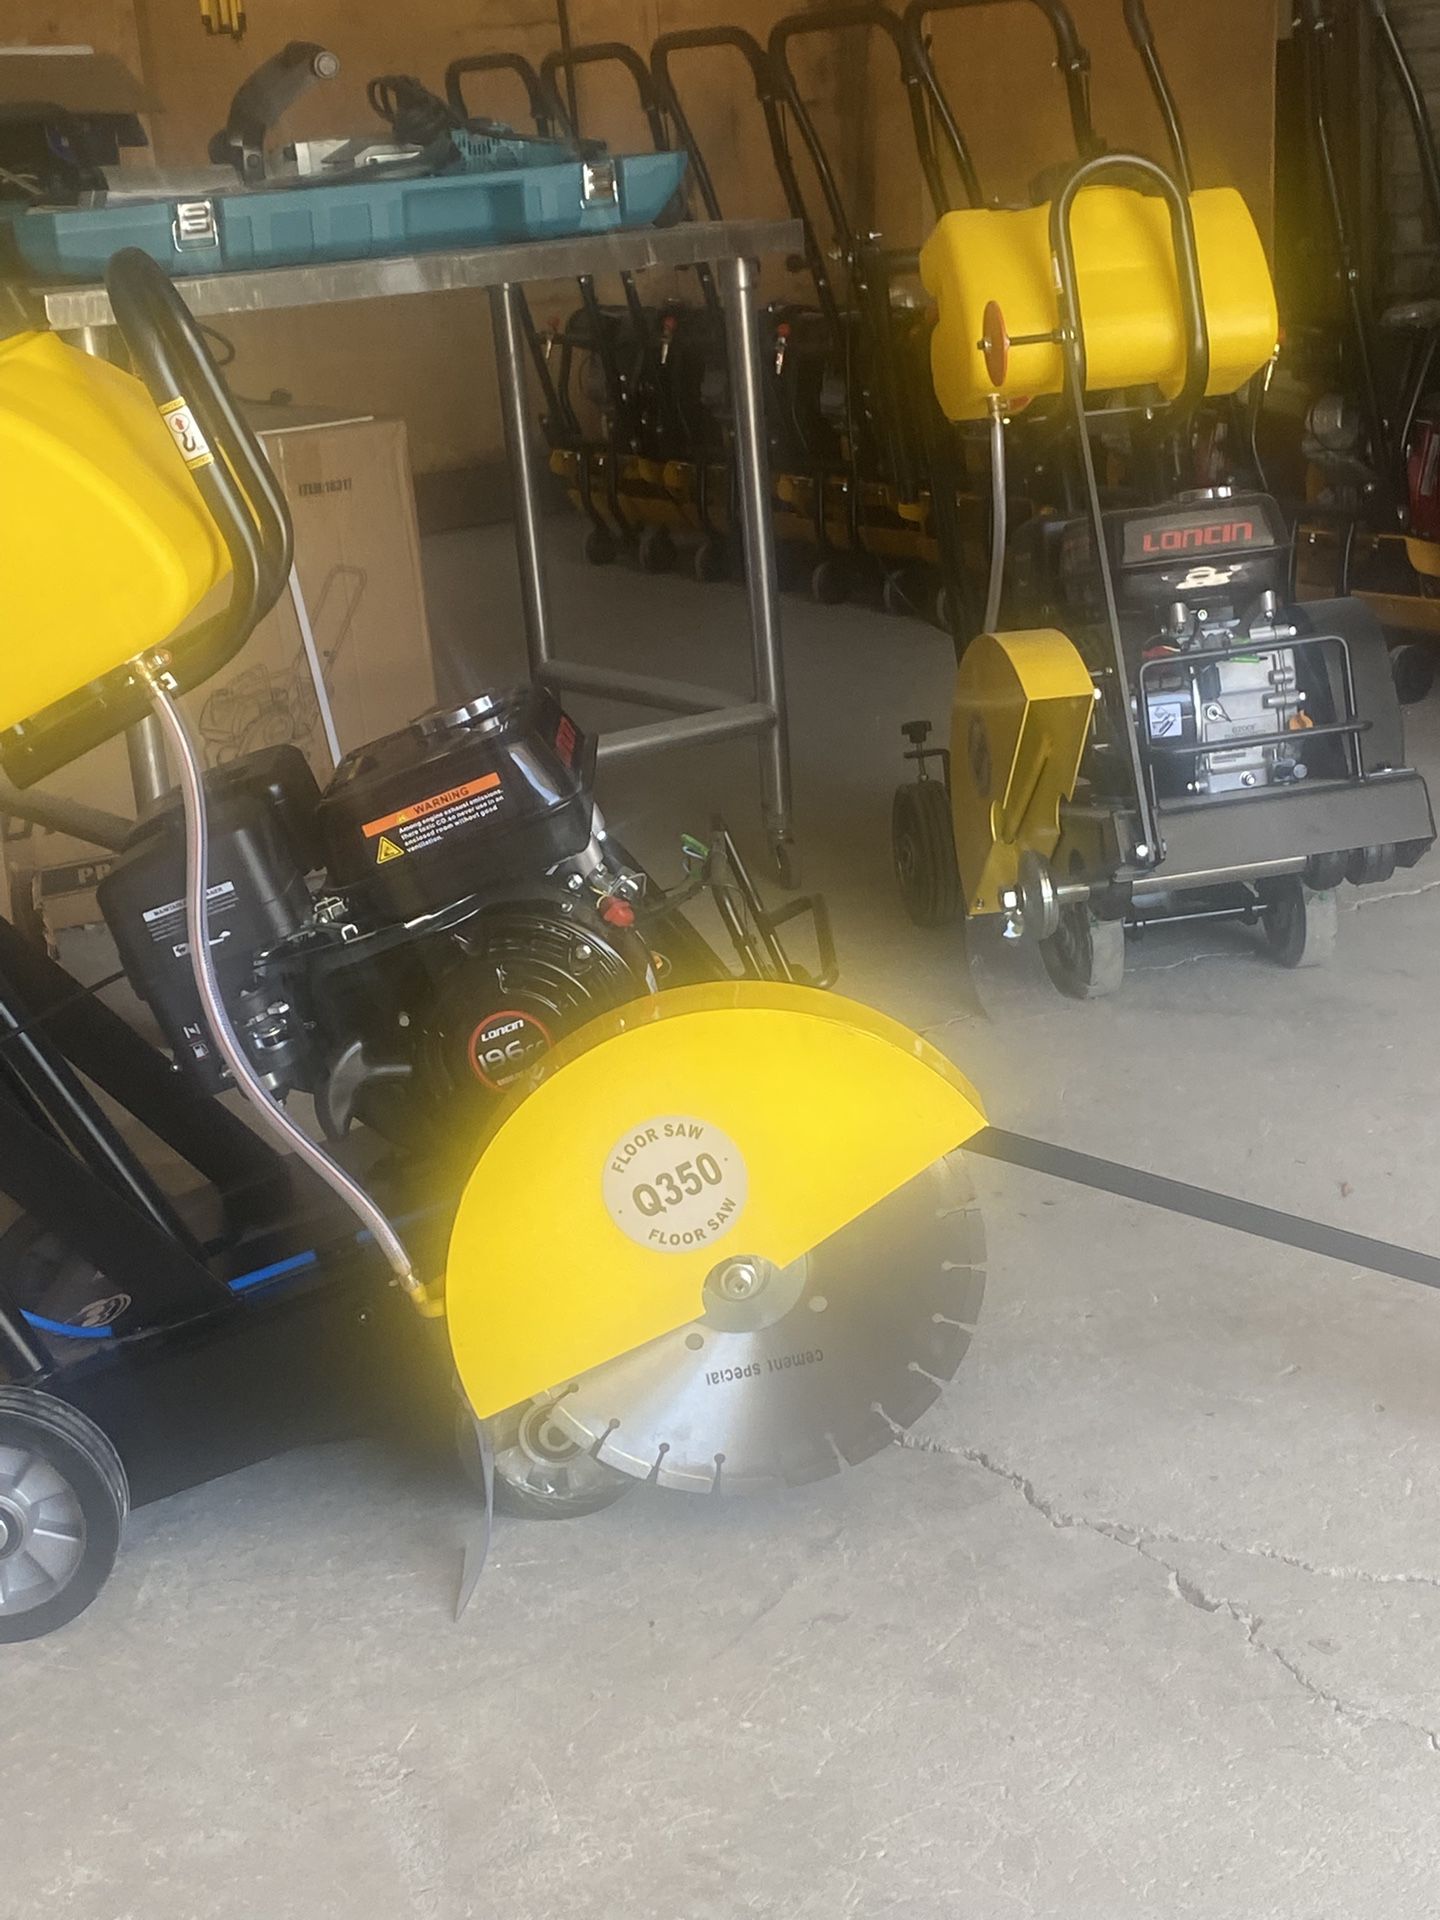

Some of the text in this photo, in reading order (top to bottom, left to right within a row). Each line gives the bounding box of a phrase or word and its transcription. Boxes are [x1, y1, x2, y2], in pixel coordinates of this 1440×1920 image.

[399, 821, 422, 834] Among
[422, 812, 444, 824] engine
[444, 801, 469, 815] exhaust
[400, 830, 419, 840] there
[419, 823, 436, 833] toxic
[456, 806, 475, 818] never
[475, 801, 488, 811] use
[487, 798, 496, 806] in
[495, 794, 504, 803] an
[413, 787, 469, 814] WARNING
[404, 804, 498, 847] enclosed room without good
[611, 1123, 704, 1173] FLOOR SAW
[632, 1152, 723, 1217] Q350
[648, 1197, 737, 1246] FLOOR SAW
[705, 1349, 824, 1386] cement special
